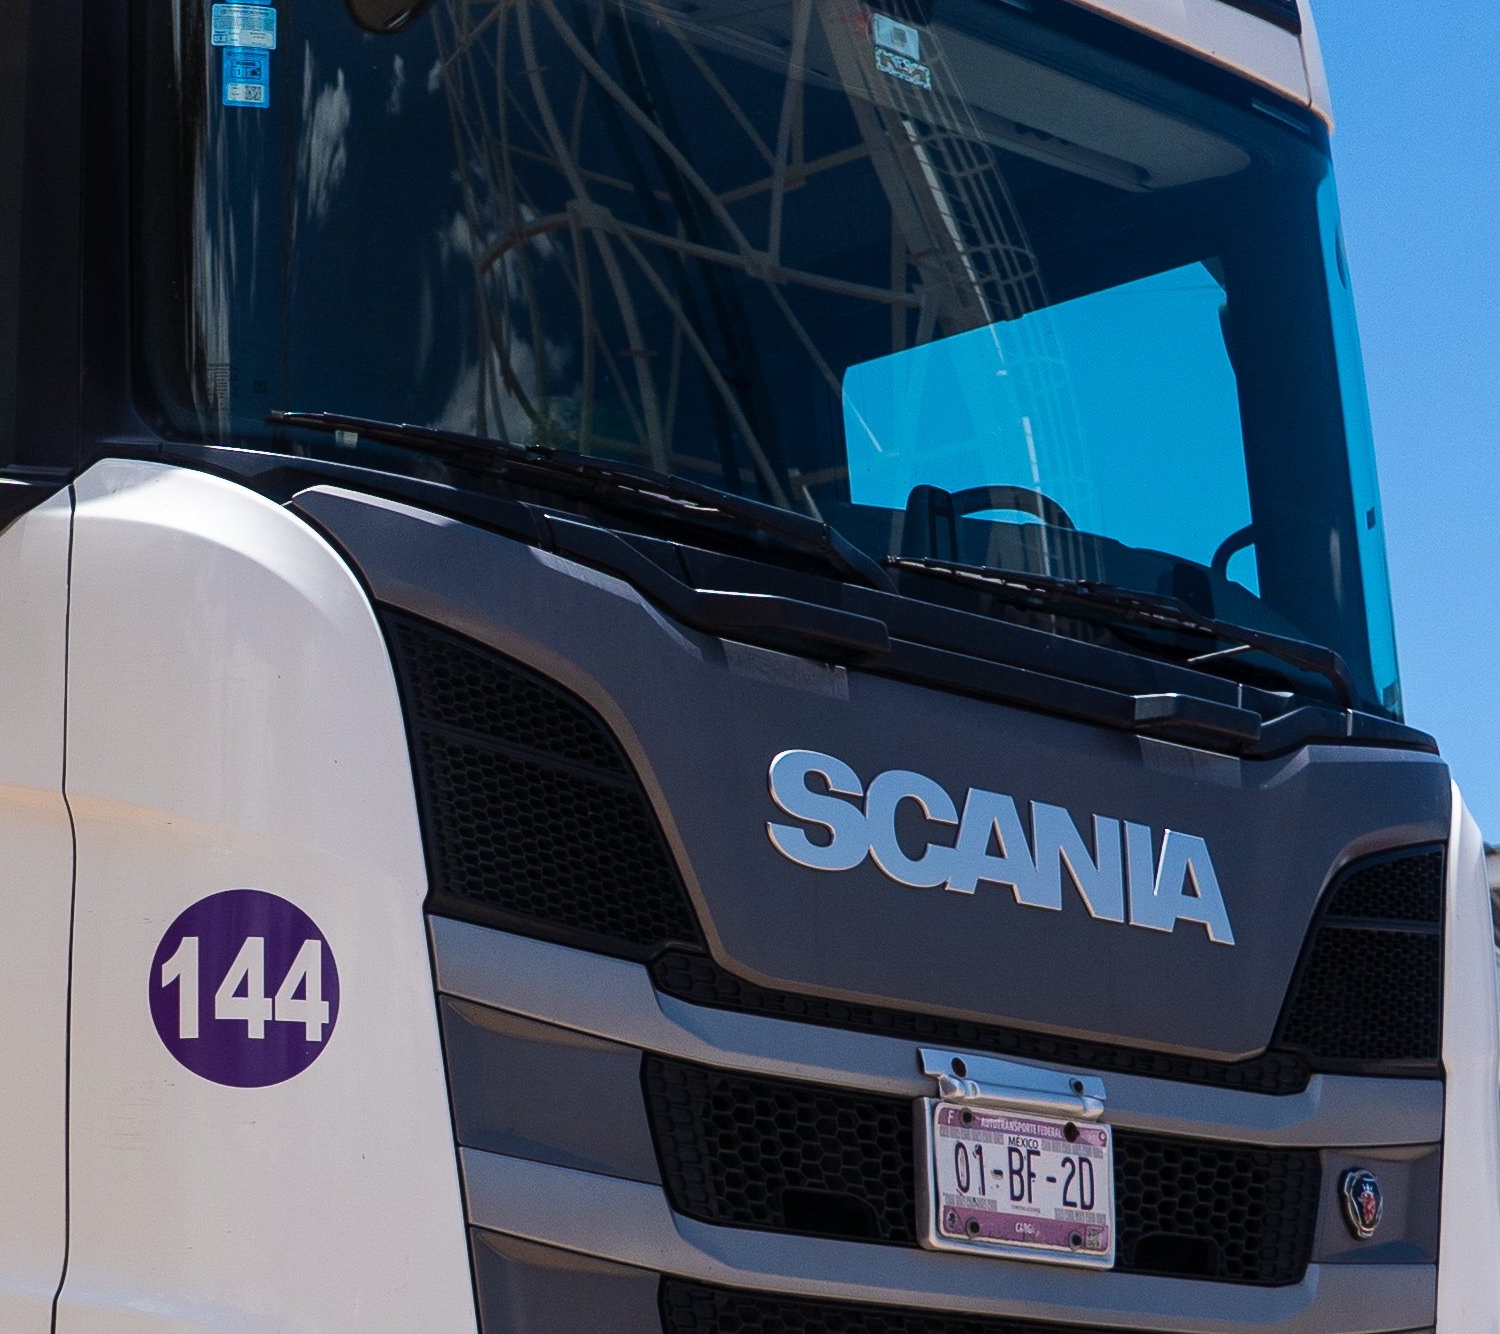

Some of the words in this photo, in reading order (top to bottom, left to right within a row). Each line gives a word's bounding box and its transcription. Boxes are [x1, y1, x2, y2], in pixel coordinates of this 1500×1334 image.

[767, 749, 1236, 946] SCANIA
[162, 936, 329, 1042] 144
[1008, 1135, 1039, 1149] MÉXICO
[1037, 1124, 1062, 1138] FEDERAL
